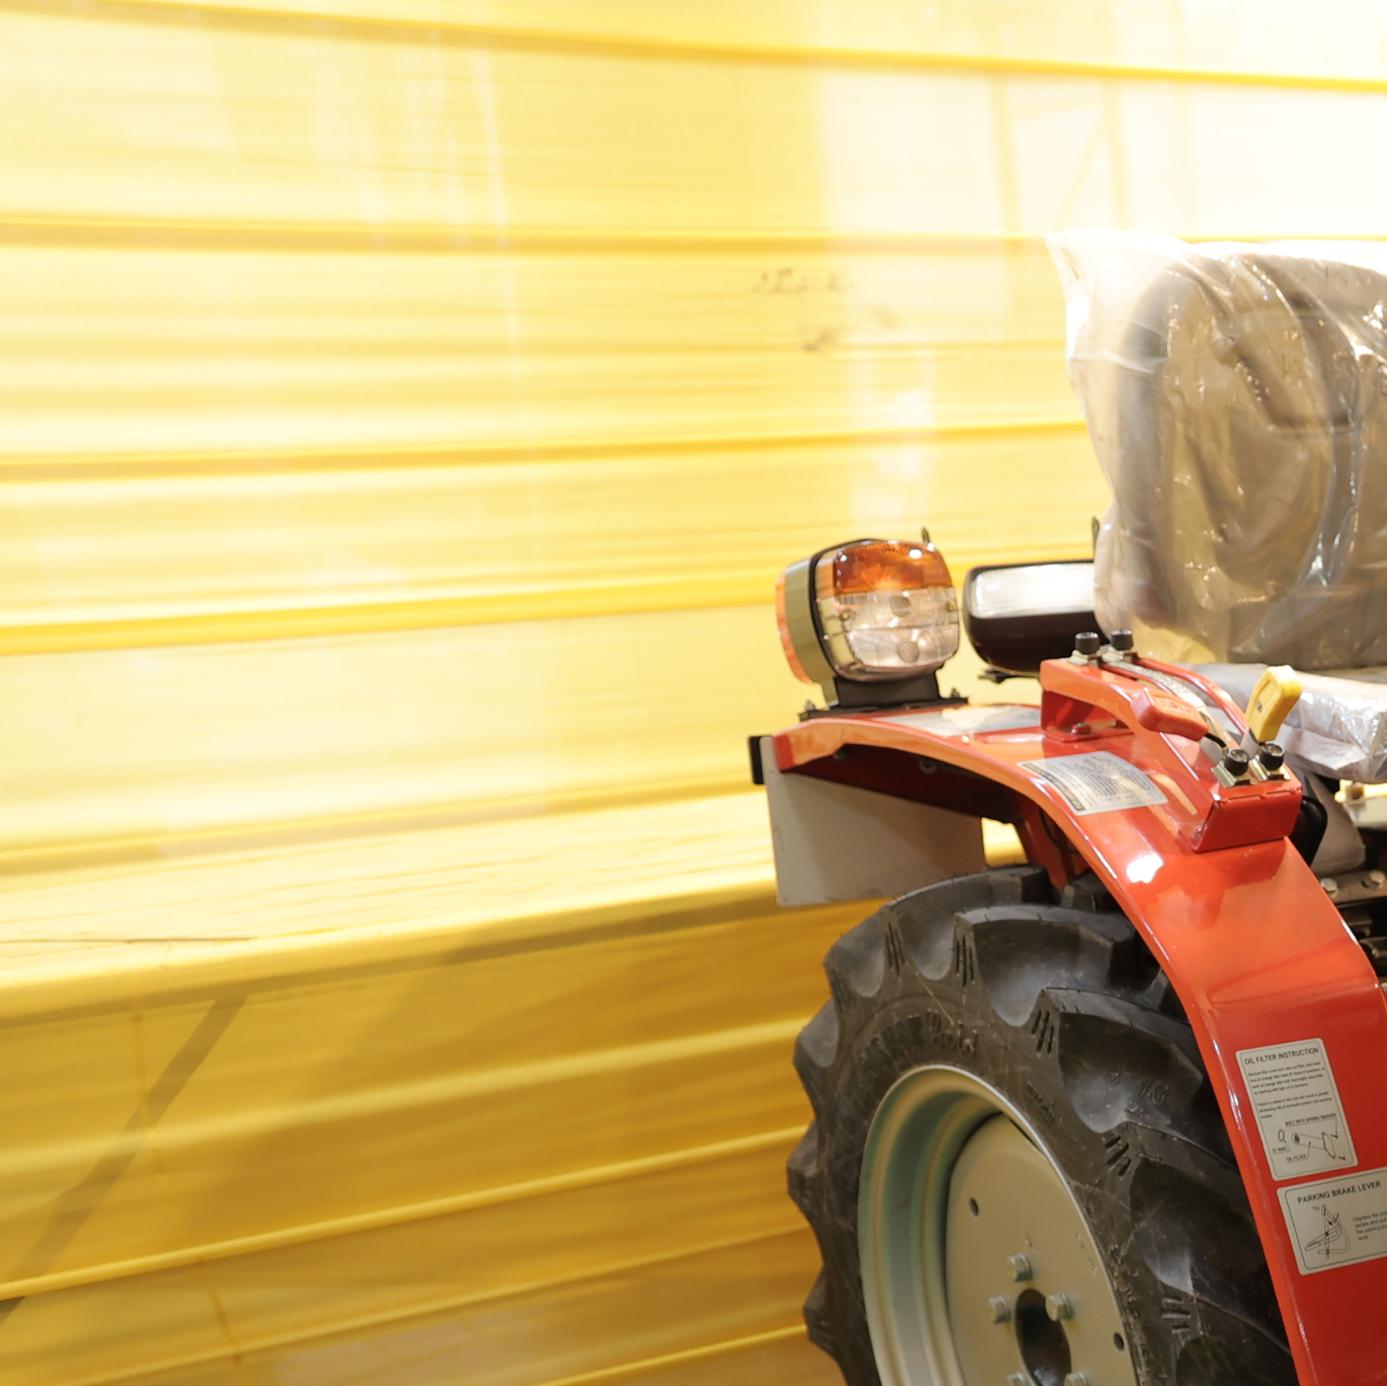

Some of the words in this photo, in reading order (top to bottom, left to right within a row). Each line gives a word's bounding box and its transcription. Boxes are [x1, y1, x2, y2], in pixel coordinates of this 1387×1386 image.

[1256, 1052, 1277, 1063] FILTER
[1278, 1047, 1320, 1060] INSTRUCTION
[1297, 1191, 1331, 1204] PARKING
[1331, 1186, 1356, 1200] BRAKE
[1357, 1180, 1382, 1193] LEVER
